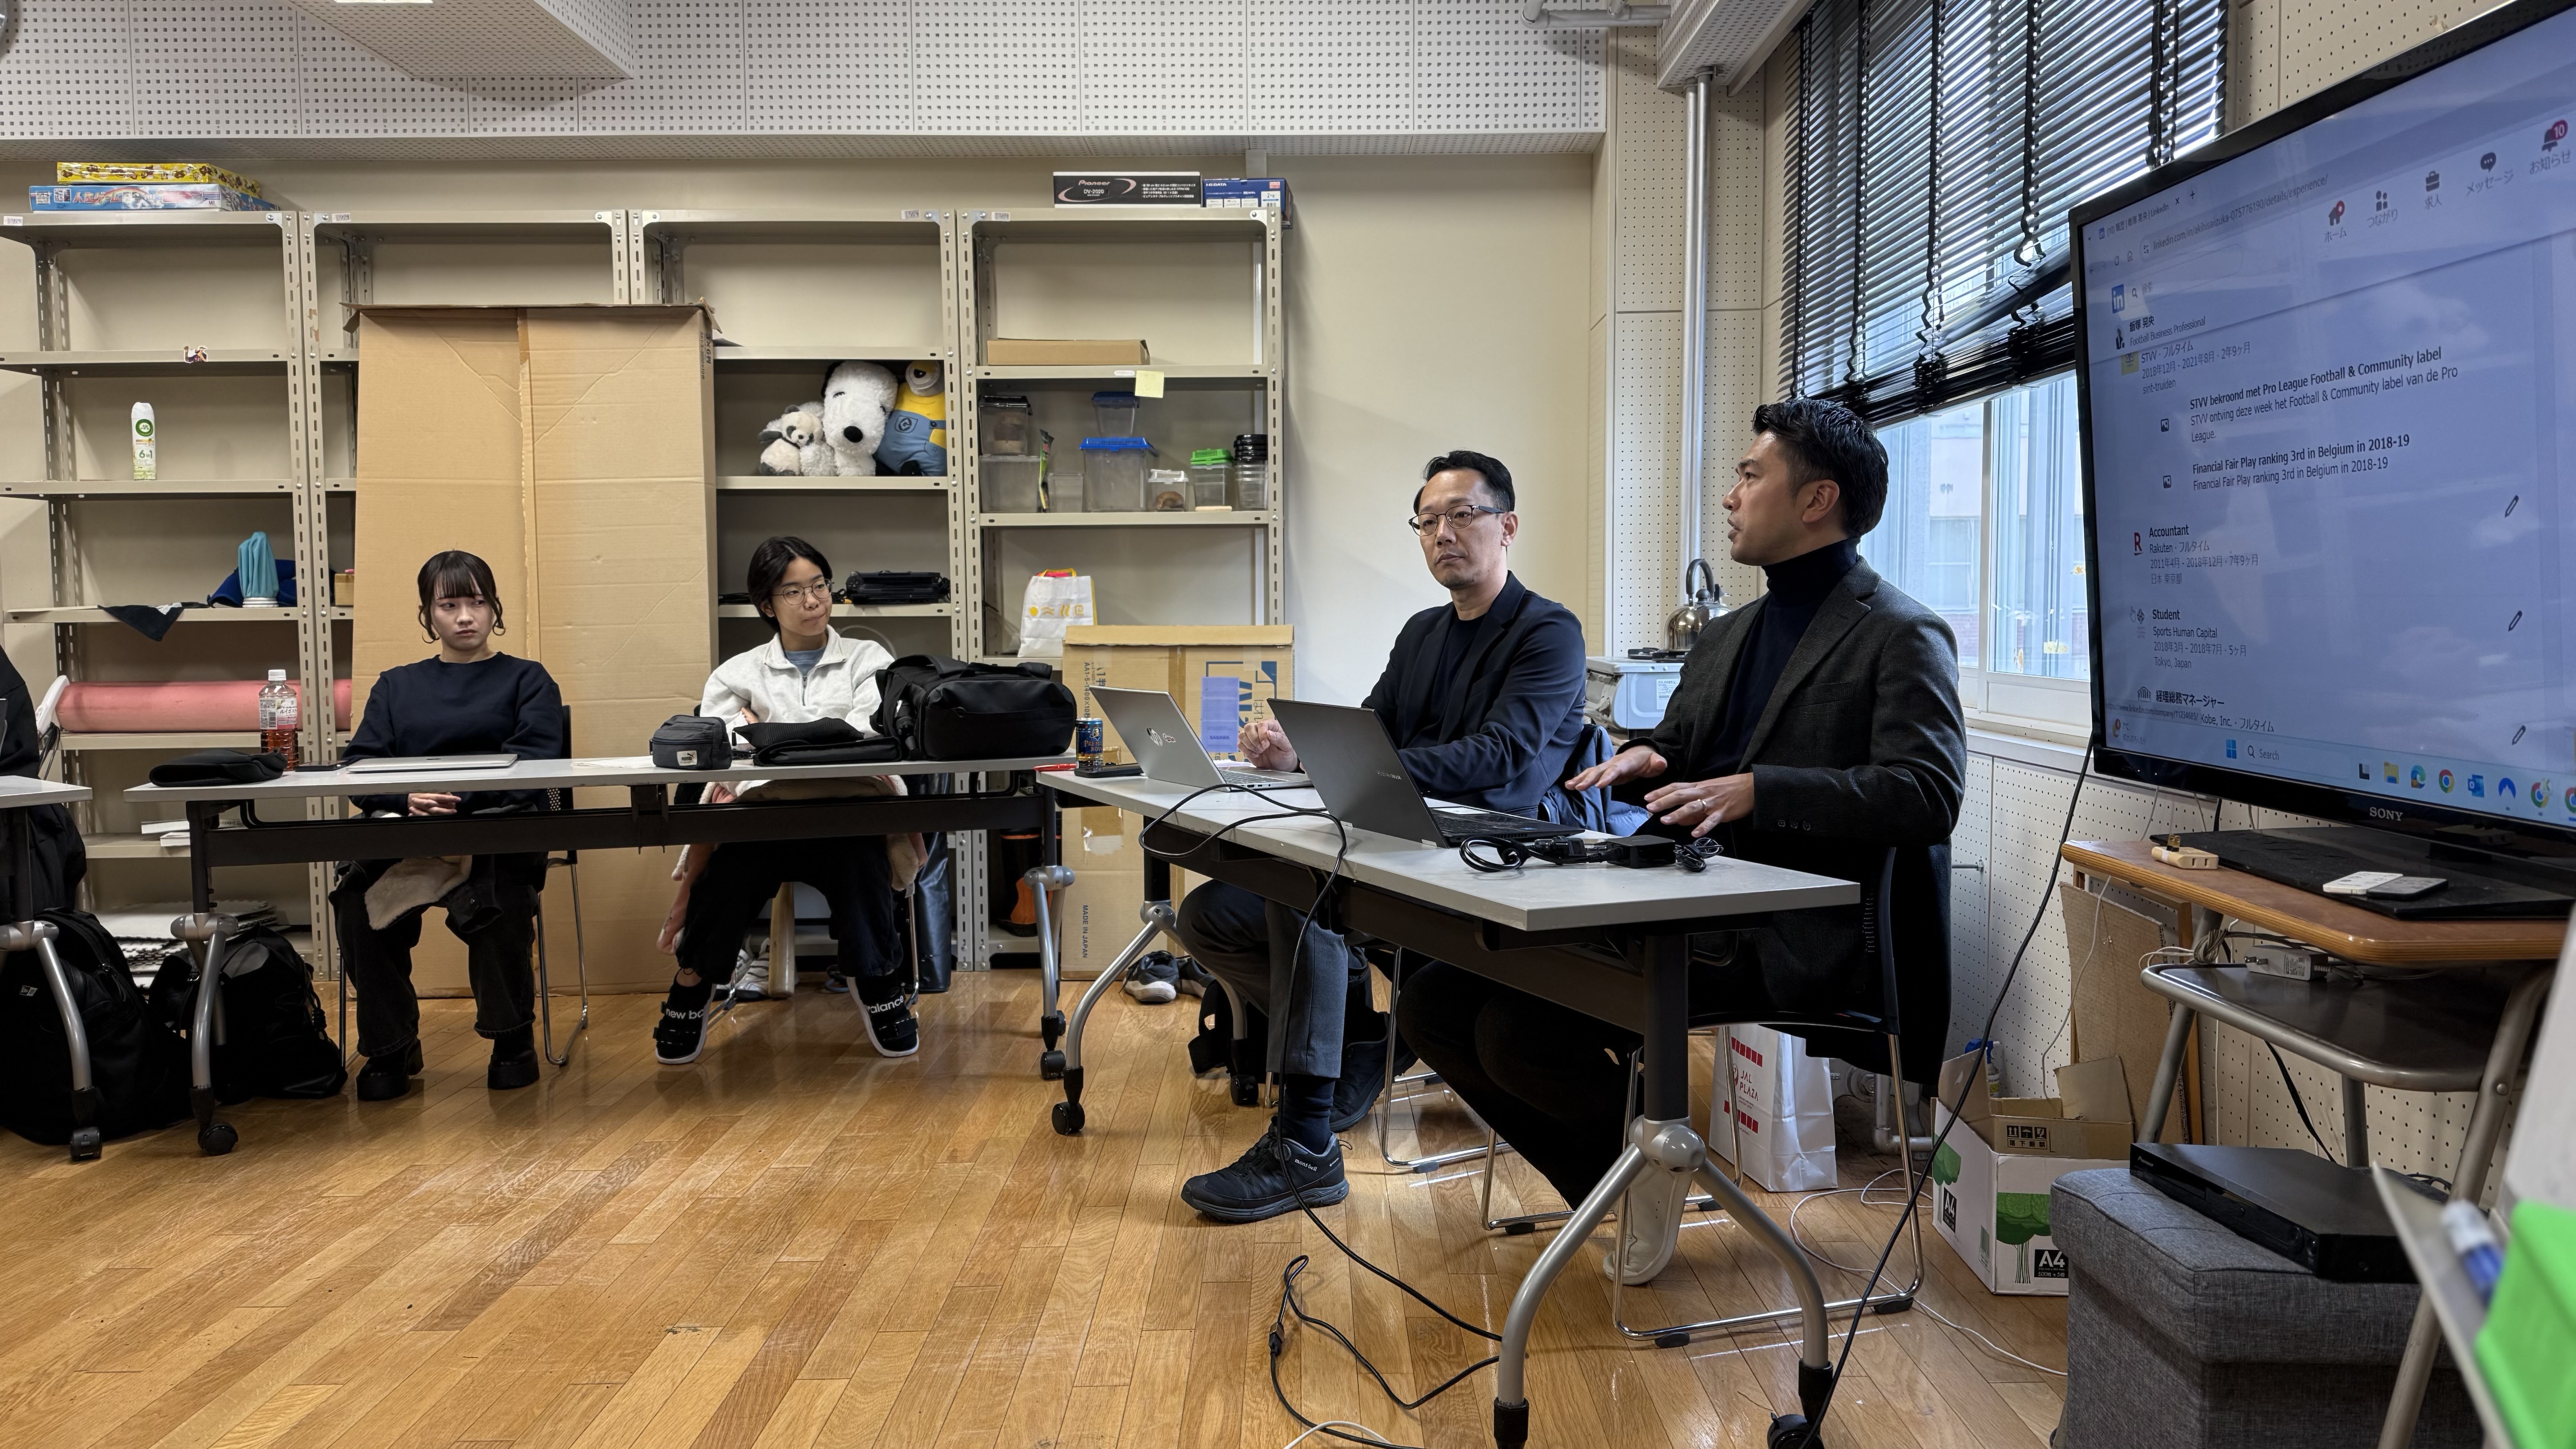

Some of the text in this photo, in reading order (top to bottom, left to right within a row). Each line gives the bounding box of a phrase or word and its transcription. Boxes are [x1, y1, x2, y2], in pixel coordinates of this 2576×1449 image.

[2555, 124, 2565, 138] 10
[2530, 150, 2570, 175] お知らせ
[2467, 170, 2513, 196] メッセージ
[2425, 195, 2442, 210] 求人
[2367, 209, 2398, 228] つながり
[2324, 227, 2346, 242] ホーム
[2130, 316, 2206, 347] Football Business Professional
[2142, 350, 2157, 363] STVV
[2163, 341, 2193, 358] フルタイム
[2142, 361, 2176, 379] 2018年12月
[2183, 351, 2214, 369] 2021年8月
[2190, 346, 2442, 409] STVV bekroond met Pro League Football & Community label
[2143, 379, 2176, 395] sint-truiden
[2190, 366, 2458, 426] STVV ontving deze week het Football & Community label van de Pro
[2191, 430, 2216, 443] League.
[2193, 434, 2410, 474] Financial Fair Play ranking 3rd in Belgium in 2018-19
[2193, 456, 2388, 491] Financial Fair Play ranking 3rd in Belgium in 2018-19
[2149, 524, 2189, 538] Accountant
[2134, 532, 2143, 552] R
[2150, 543, 2173, 553] Rakuten
[2179, 540, 2210, 553] フルタイム
[2150, 557, 2180, 569] 2011年4月
[2186, 555, 2222, 568] 2018年12月
[2151, 573, 2182, 584] 日本 東京都
[2152, 609, 2180, 620] Student
[2153, 626, 2171, 638] Sports
[2173, 627, 2194, 638] Human
[2196, 627, 2217, 639] Capital
[2154, 641, 2183, 653] 2018年3月
[2190, 643, 2222, 655] 2018年7月
[2154, 657, 2191, 670] Tokyo, Japan
[2156, 690, 2225, 709] 経理総務マネージャー
[2200, 713, 2218, 727] Kobe,
[2220, 715, 2232, 727] Inc.
[2239, 718, 2275, 733] フルタイム
[2259, 750, 2279, 761] Search
[2369, 807, 2403, 821] SONY
[666, 1008, 686, 1019] new
[1740, 1070, 1752, 1083] JAL
[1740, 1082, 1758, 1101] PLAZA
[1945, 1192, 1955, 1217] A4
[2039, 1251, 2065, 1267] A4
